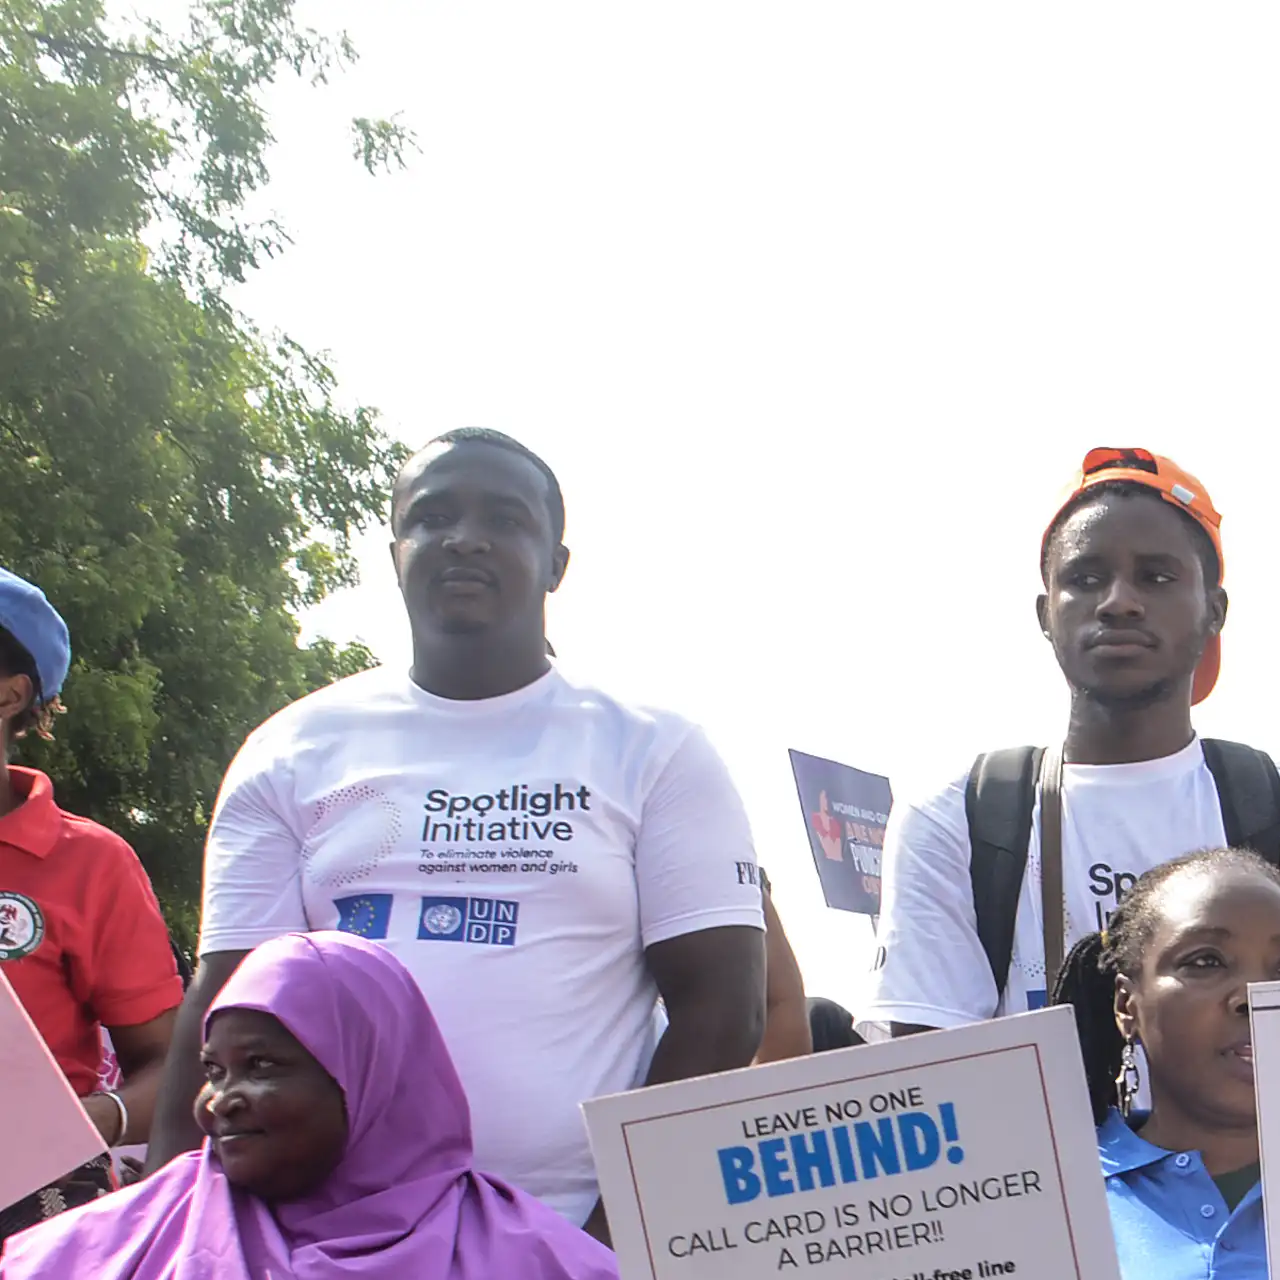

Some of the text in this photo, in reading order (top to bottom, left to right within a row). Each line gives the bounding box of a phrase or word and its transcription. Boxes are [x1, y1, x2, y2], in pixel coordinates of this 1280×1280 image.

[423, 783, 591, 818] Spotlight
[421, 815, 574, 842] Initiative
[418, 860, 578, 875] against women and girls
[420, 847, 554, 859] To eliminate violence
[1088, 863, 1137, 905] Sp
[741, 1087, 925, 1139] LEAVE NO ONE
[716, 1102, 965, 1206] BEHIND!
[668, 1169, 1043, 1259] CALL CARD IS NO LONGER
[777, 1220, 945, 1271] A BARRIER!!
[978, 1258, 1016, 1280] line
